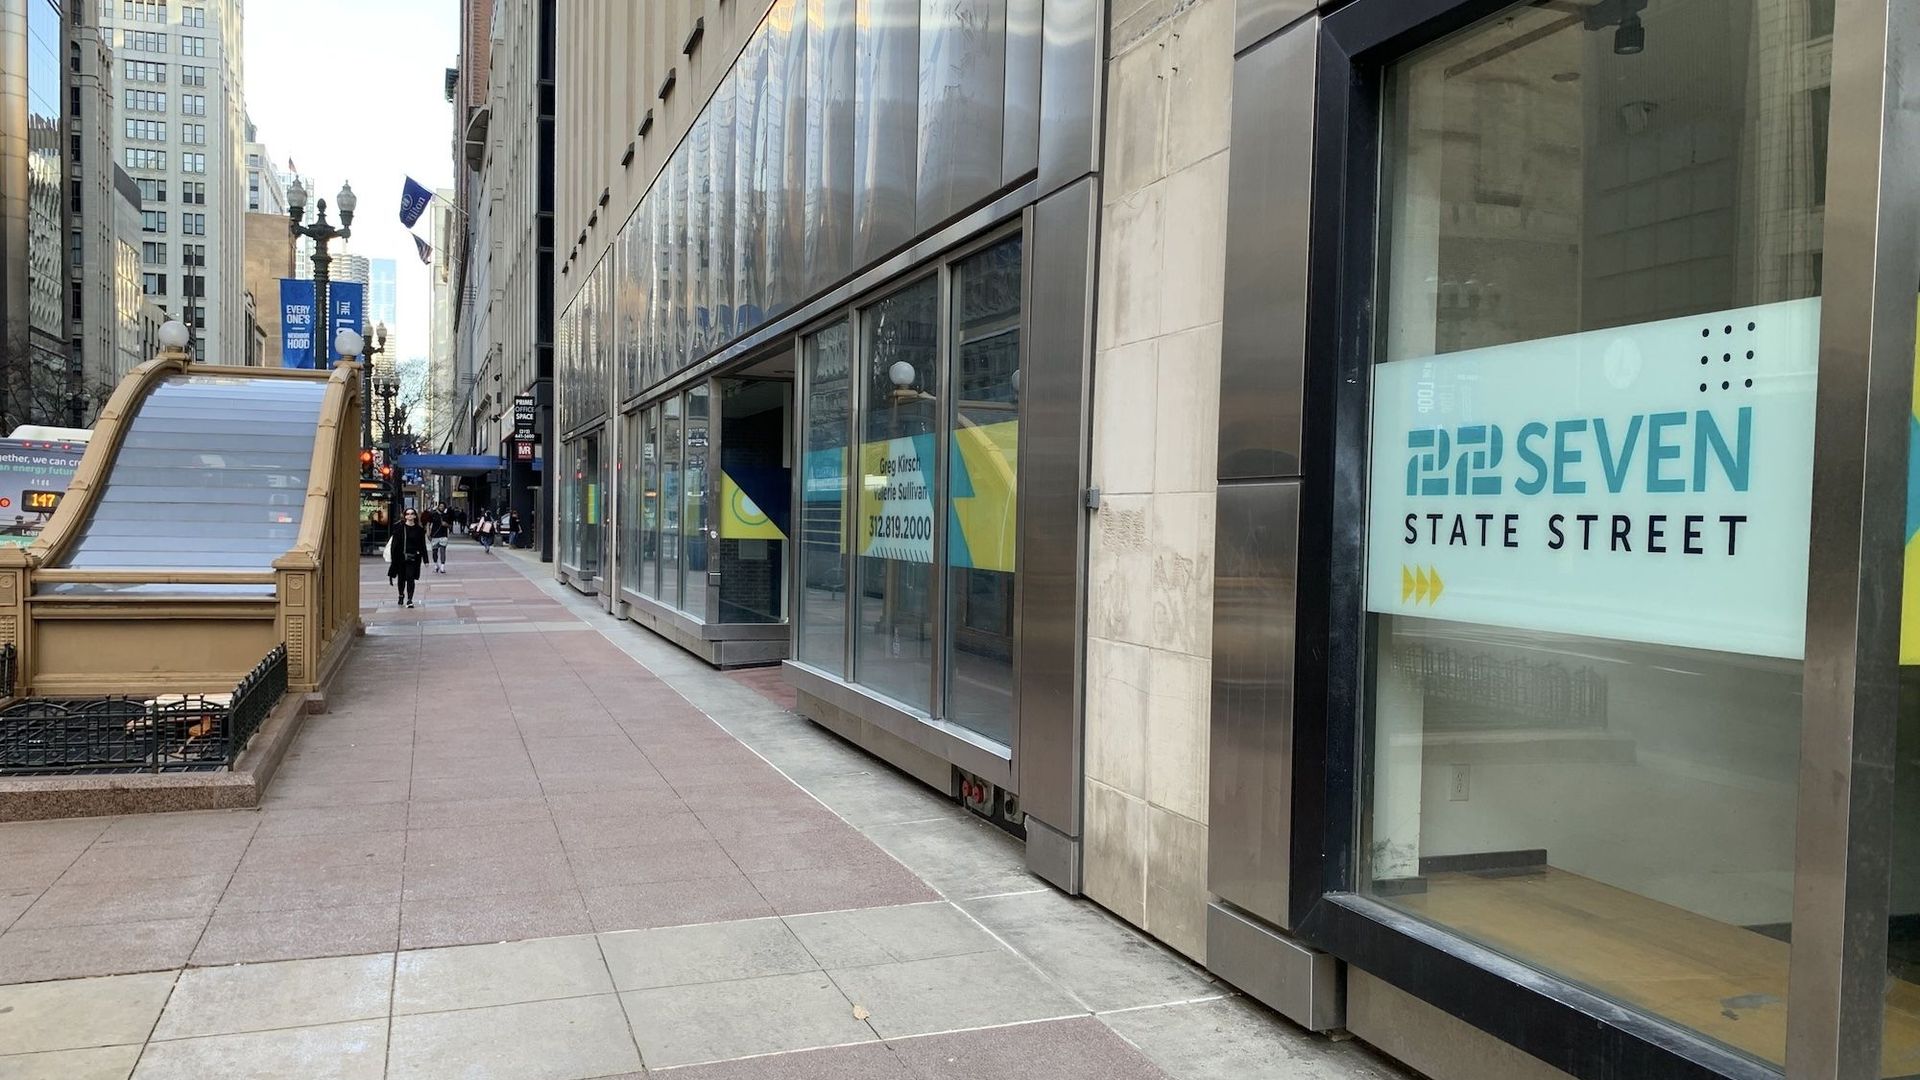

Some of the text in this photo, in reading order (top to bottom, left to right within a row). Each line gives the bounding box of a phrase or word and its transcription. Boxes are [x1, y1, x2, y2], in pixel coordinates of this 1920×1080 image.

[286, 305, 310, 314] EVERY
[340, 301, 351, 315] THE
[286, 314, 310, 324] ONE'S
[287, 339, 310, 349] HOOD
[518, 447, 531, 455] MR
[1514, 406, 1752, 496] SEVEN
[13, 465, 46, 474] energy
[880, 454, 921, 476] Greg Kirsch
[898, 483, 928, 500] Sullivan
[31, 493, 56, 507] 147
[868, 515, 931, 540] 312.819.2000
[1404, 513, 1748, 556] STATE STREET
